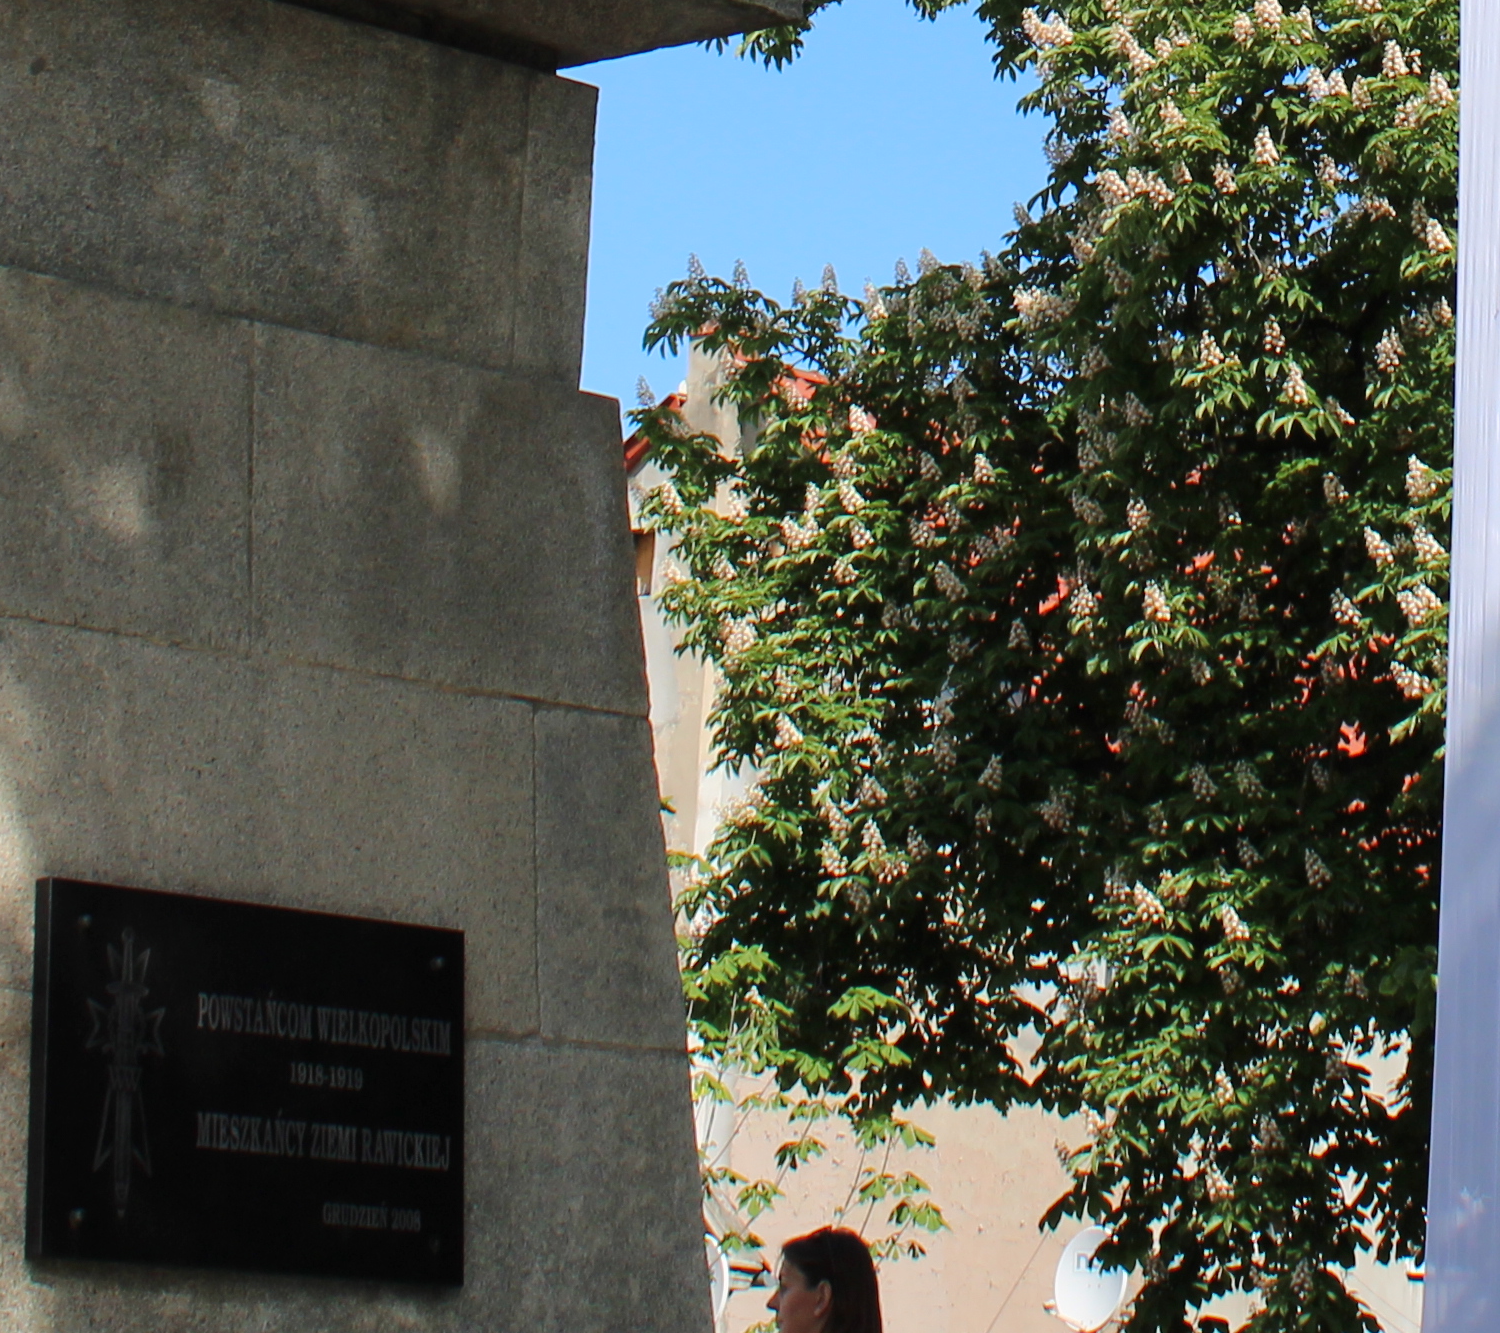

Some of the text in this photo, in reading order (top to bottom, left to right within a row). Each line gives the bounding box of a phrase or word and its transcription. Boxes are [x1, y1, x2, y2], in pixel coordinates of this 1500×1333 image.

[197, 990, 452, 1055] POWSTAŃCOM WIELKOPOLSKIM
[290, 1061, 364, 1091] 1918-1919
[196, 1108, 451, 1171] MIESZKAŃCY ZIEMI RAWICKIEJ
[322, 1201, 421, 1233] GRUDZIEŃ 2008
